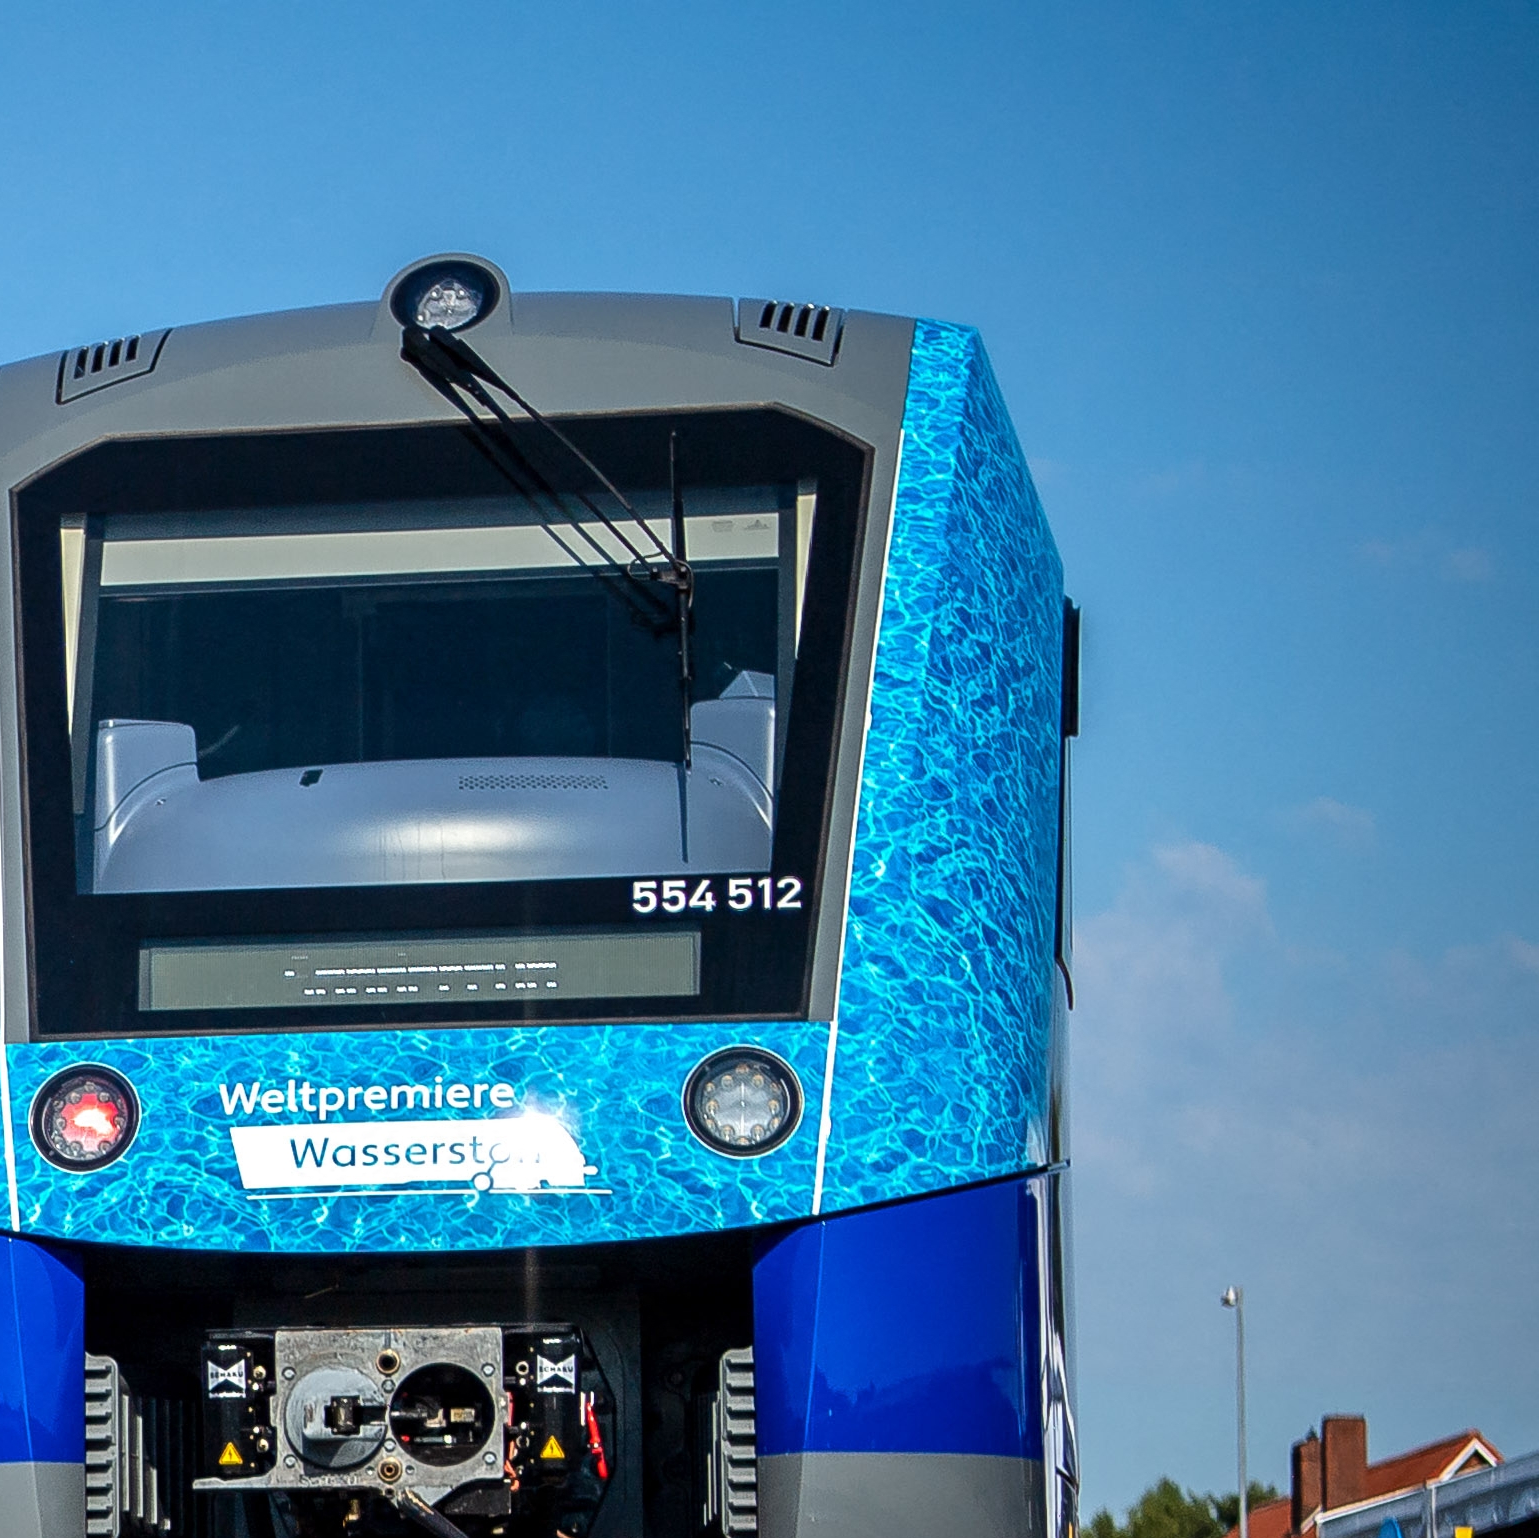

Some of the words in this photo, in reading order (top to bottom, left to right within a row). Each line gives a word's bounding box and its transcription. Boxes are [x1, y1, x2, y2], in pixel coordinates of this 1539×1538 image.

[632, 879, 716, 914] 554
[727, 875, 802, 911] 512
[219, 1075, 515, 1121] Weltpremiere
[289, 1133, 543, 1169] Wassersto
